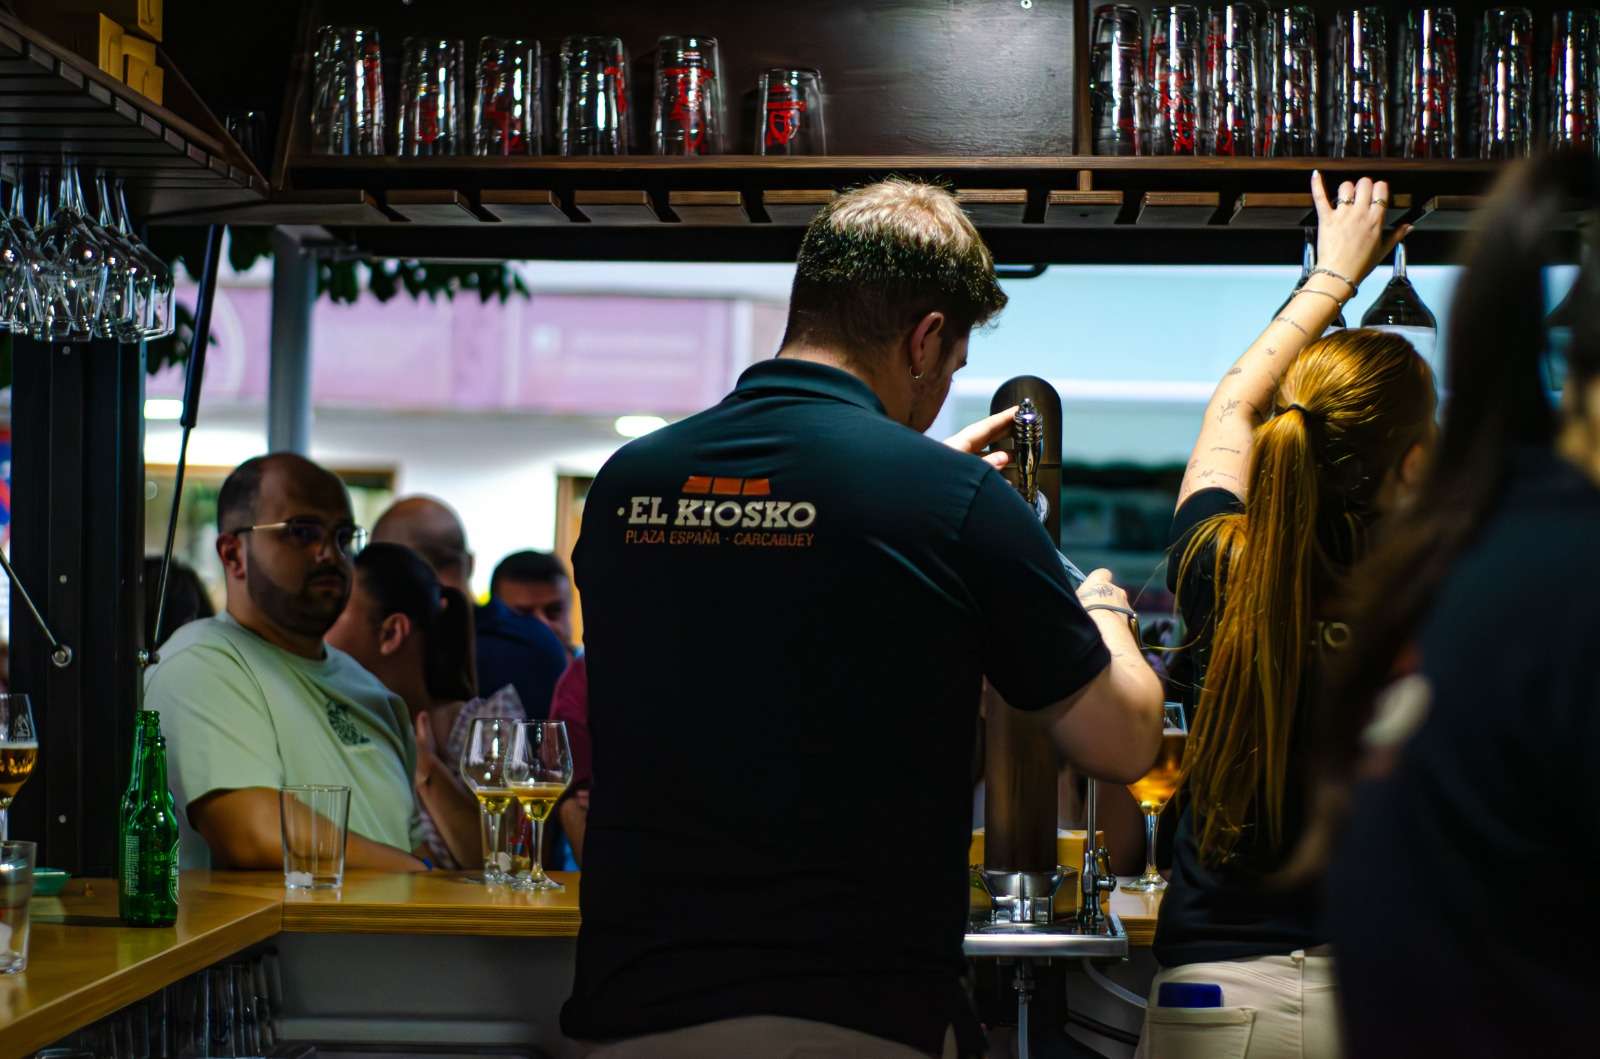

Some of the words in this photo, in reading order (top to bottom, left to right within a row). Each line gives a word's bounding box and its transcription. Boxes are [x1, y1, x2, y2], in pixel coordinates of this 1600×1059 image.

[674, 499, 816, 527] KIOSKO
[625, 530, 665, 544] PLAZA
[670, 529, 720, 544] ESPAÑA
[735, 532, 815, 546] CARCABUEY
